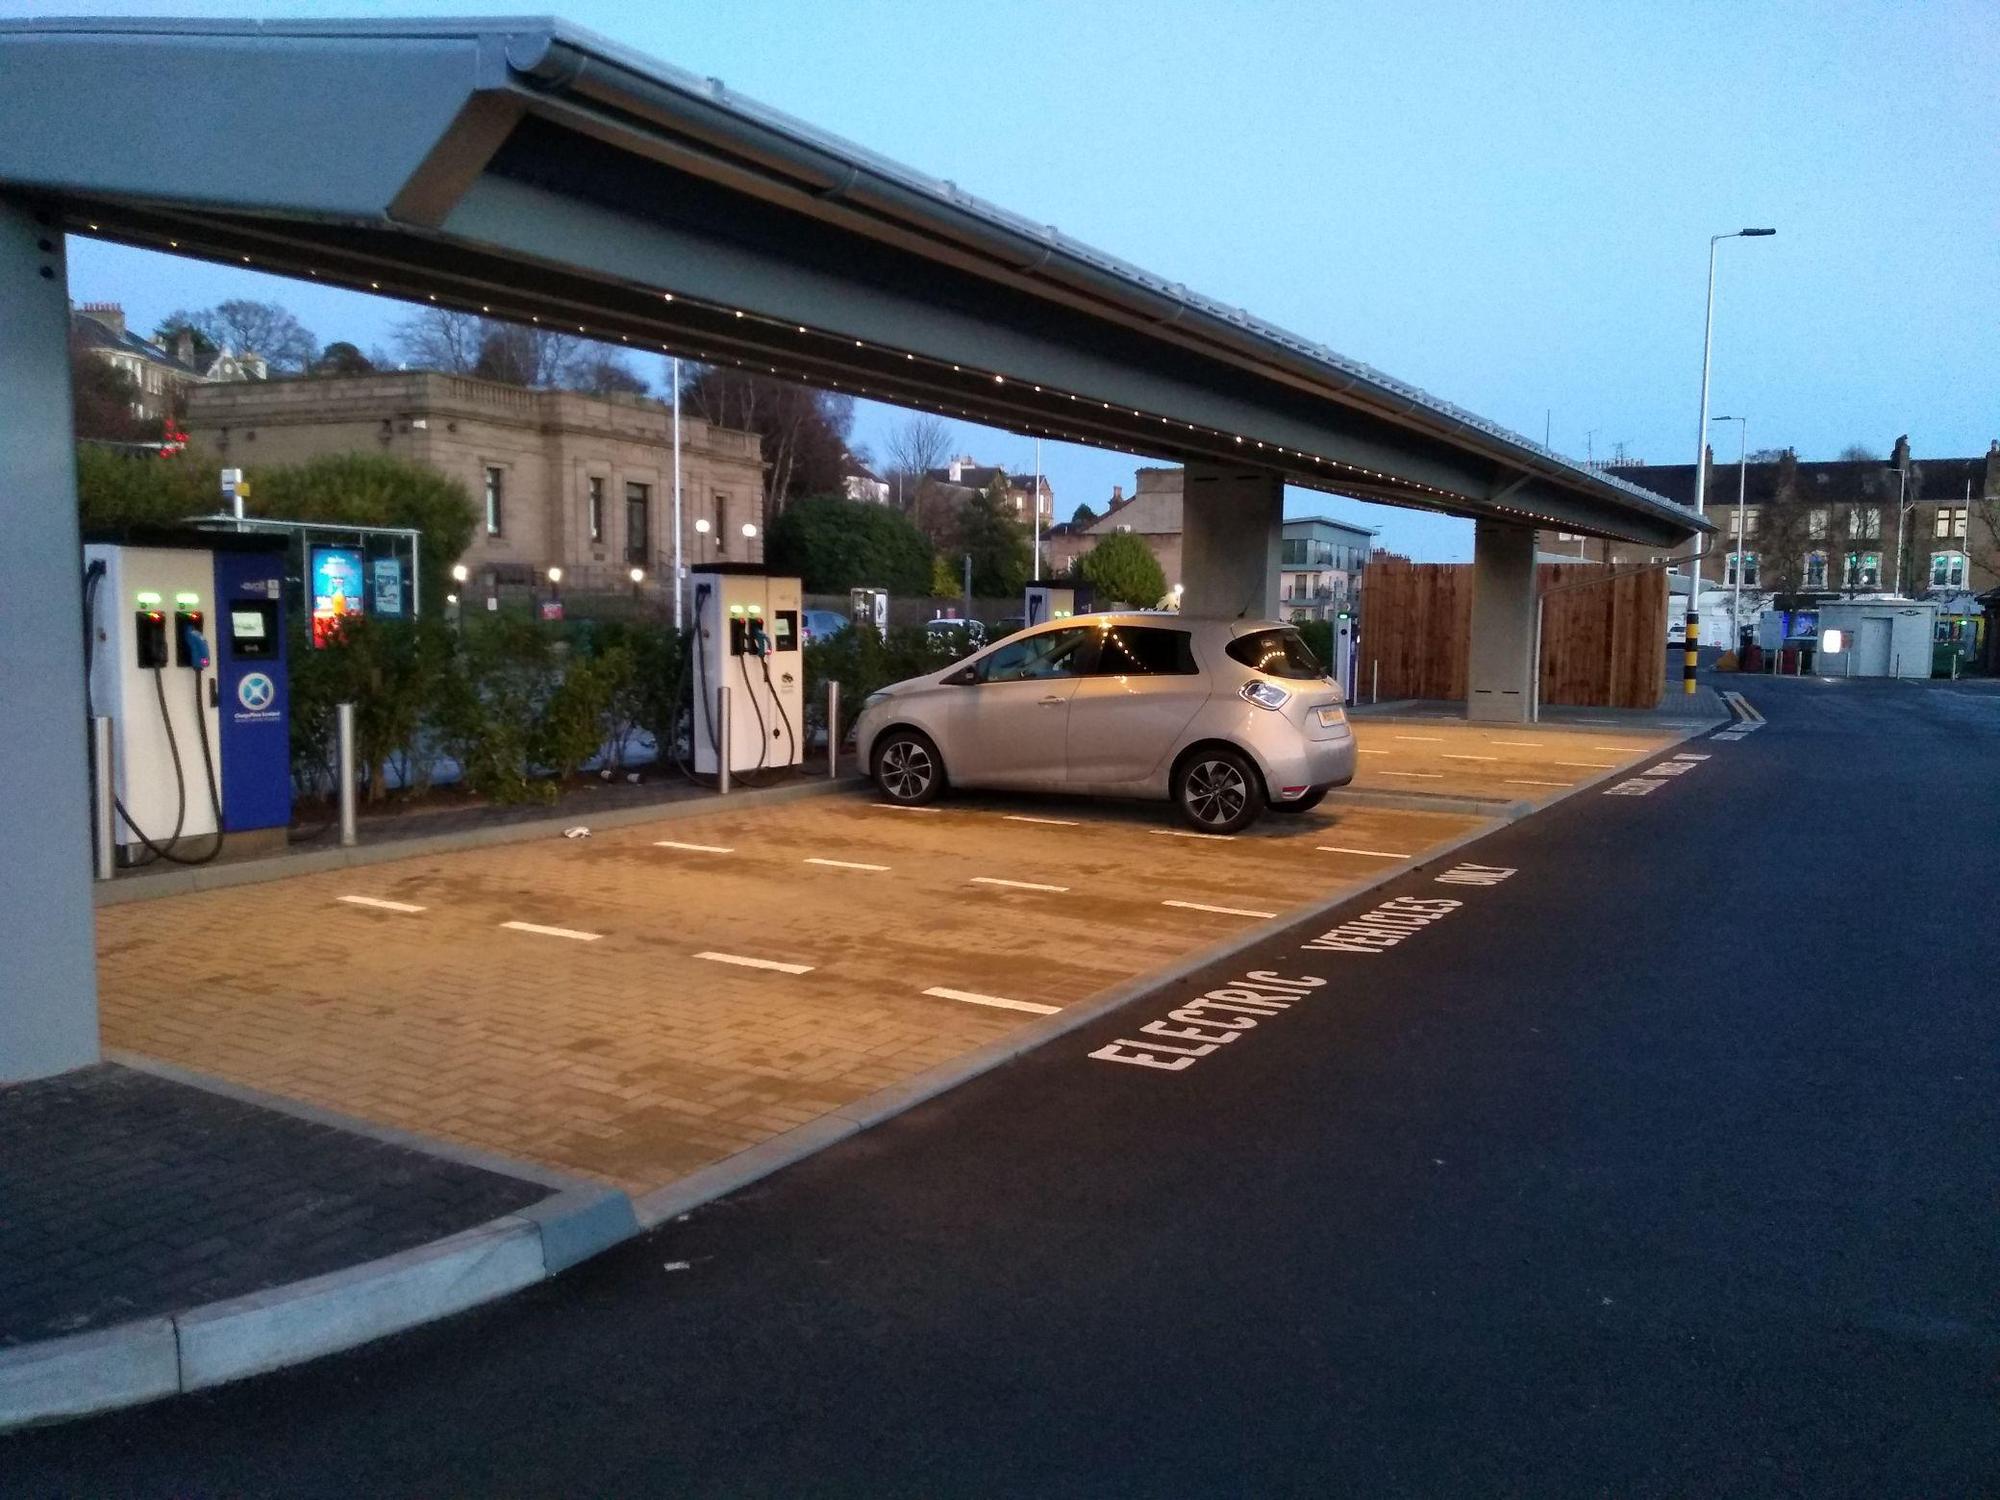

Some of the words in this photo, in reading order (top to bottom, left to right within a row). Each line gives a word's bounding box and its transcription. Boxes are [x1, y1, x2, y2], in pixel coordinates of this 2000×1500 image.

[1088, 970, 1327, 1071] ELECTRIC
[1301, 896, 1464, 953] VEHICLES
[1434, 862, 1518, 886] ONLY
